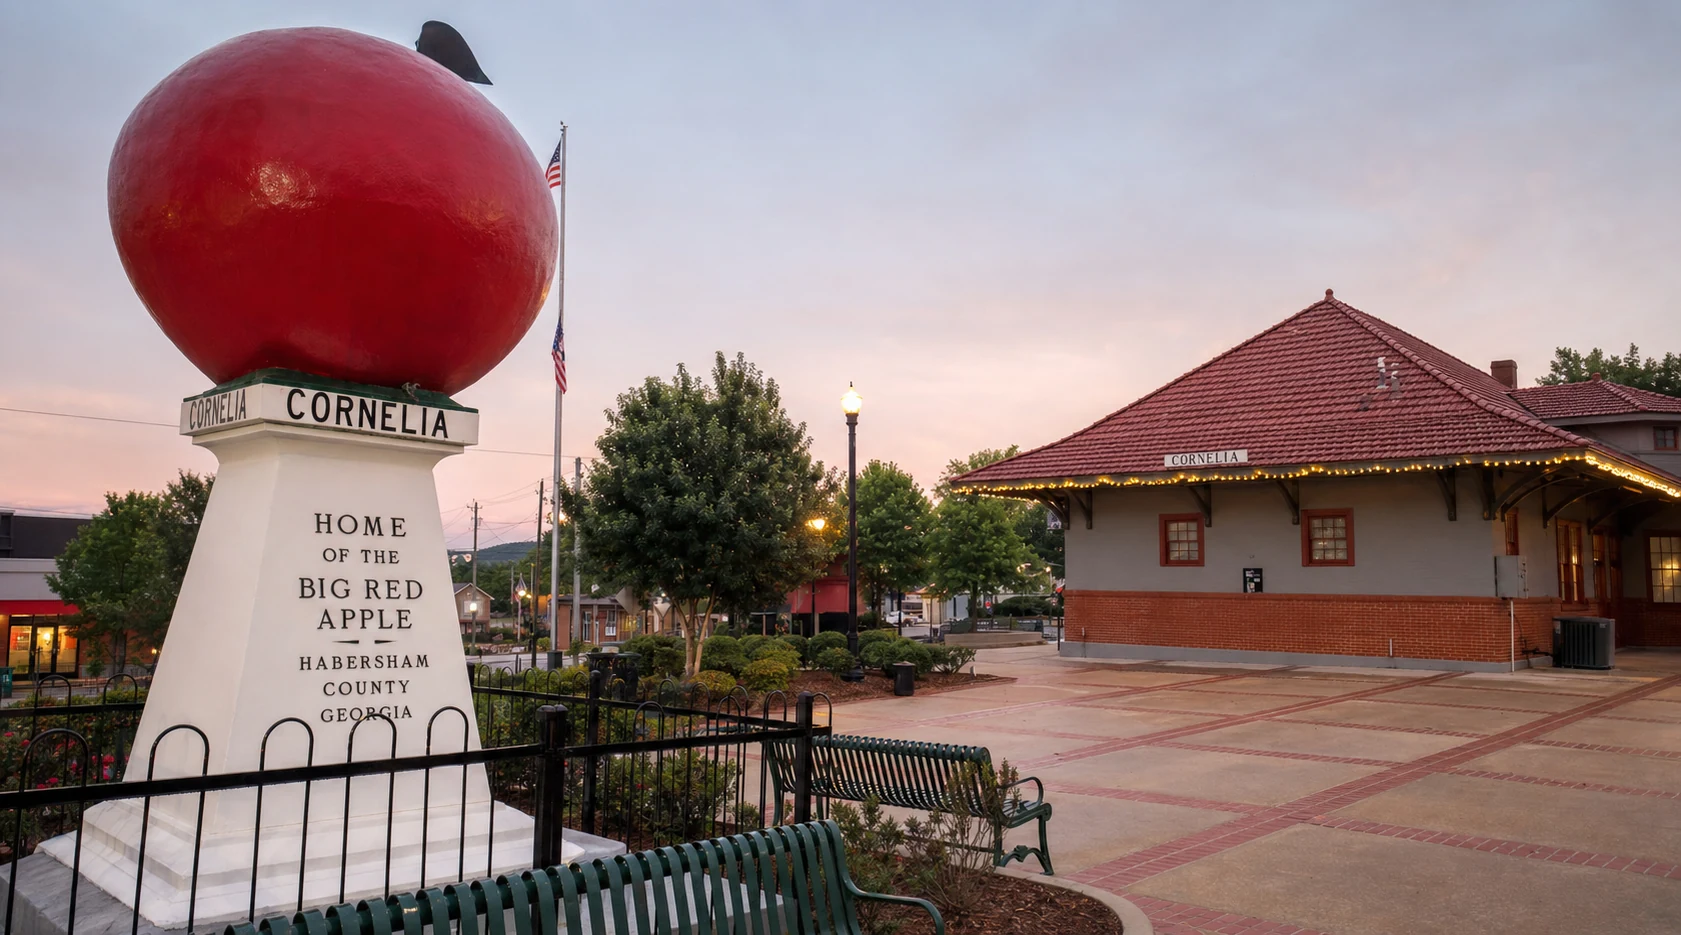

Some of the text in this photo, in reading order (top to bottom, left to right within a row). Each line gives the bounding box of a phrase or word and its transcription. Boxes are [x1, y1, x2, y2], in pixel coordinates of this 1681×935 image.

[189, 388, 247, 430] CORNELIA
[287, 388, 449, 439] CORNELIA
[1171, 451, 1238, 465] CORNELIA
[314, 513, 407, 538] HOME
[322, 548, 400, 565] OF THE
[299, 577, 424, 601] BIG RED
[317, 609, 413, 630] APPLE
[299, 655, 430, 671] HABERSHAM
[322, 680, 411, 697] COUNTY
[320, 705, 413, 723] GEORGIA
